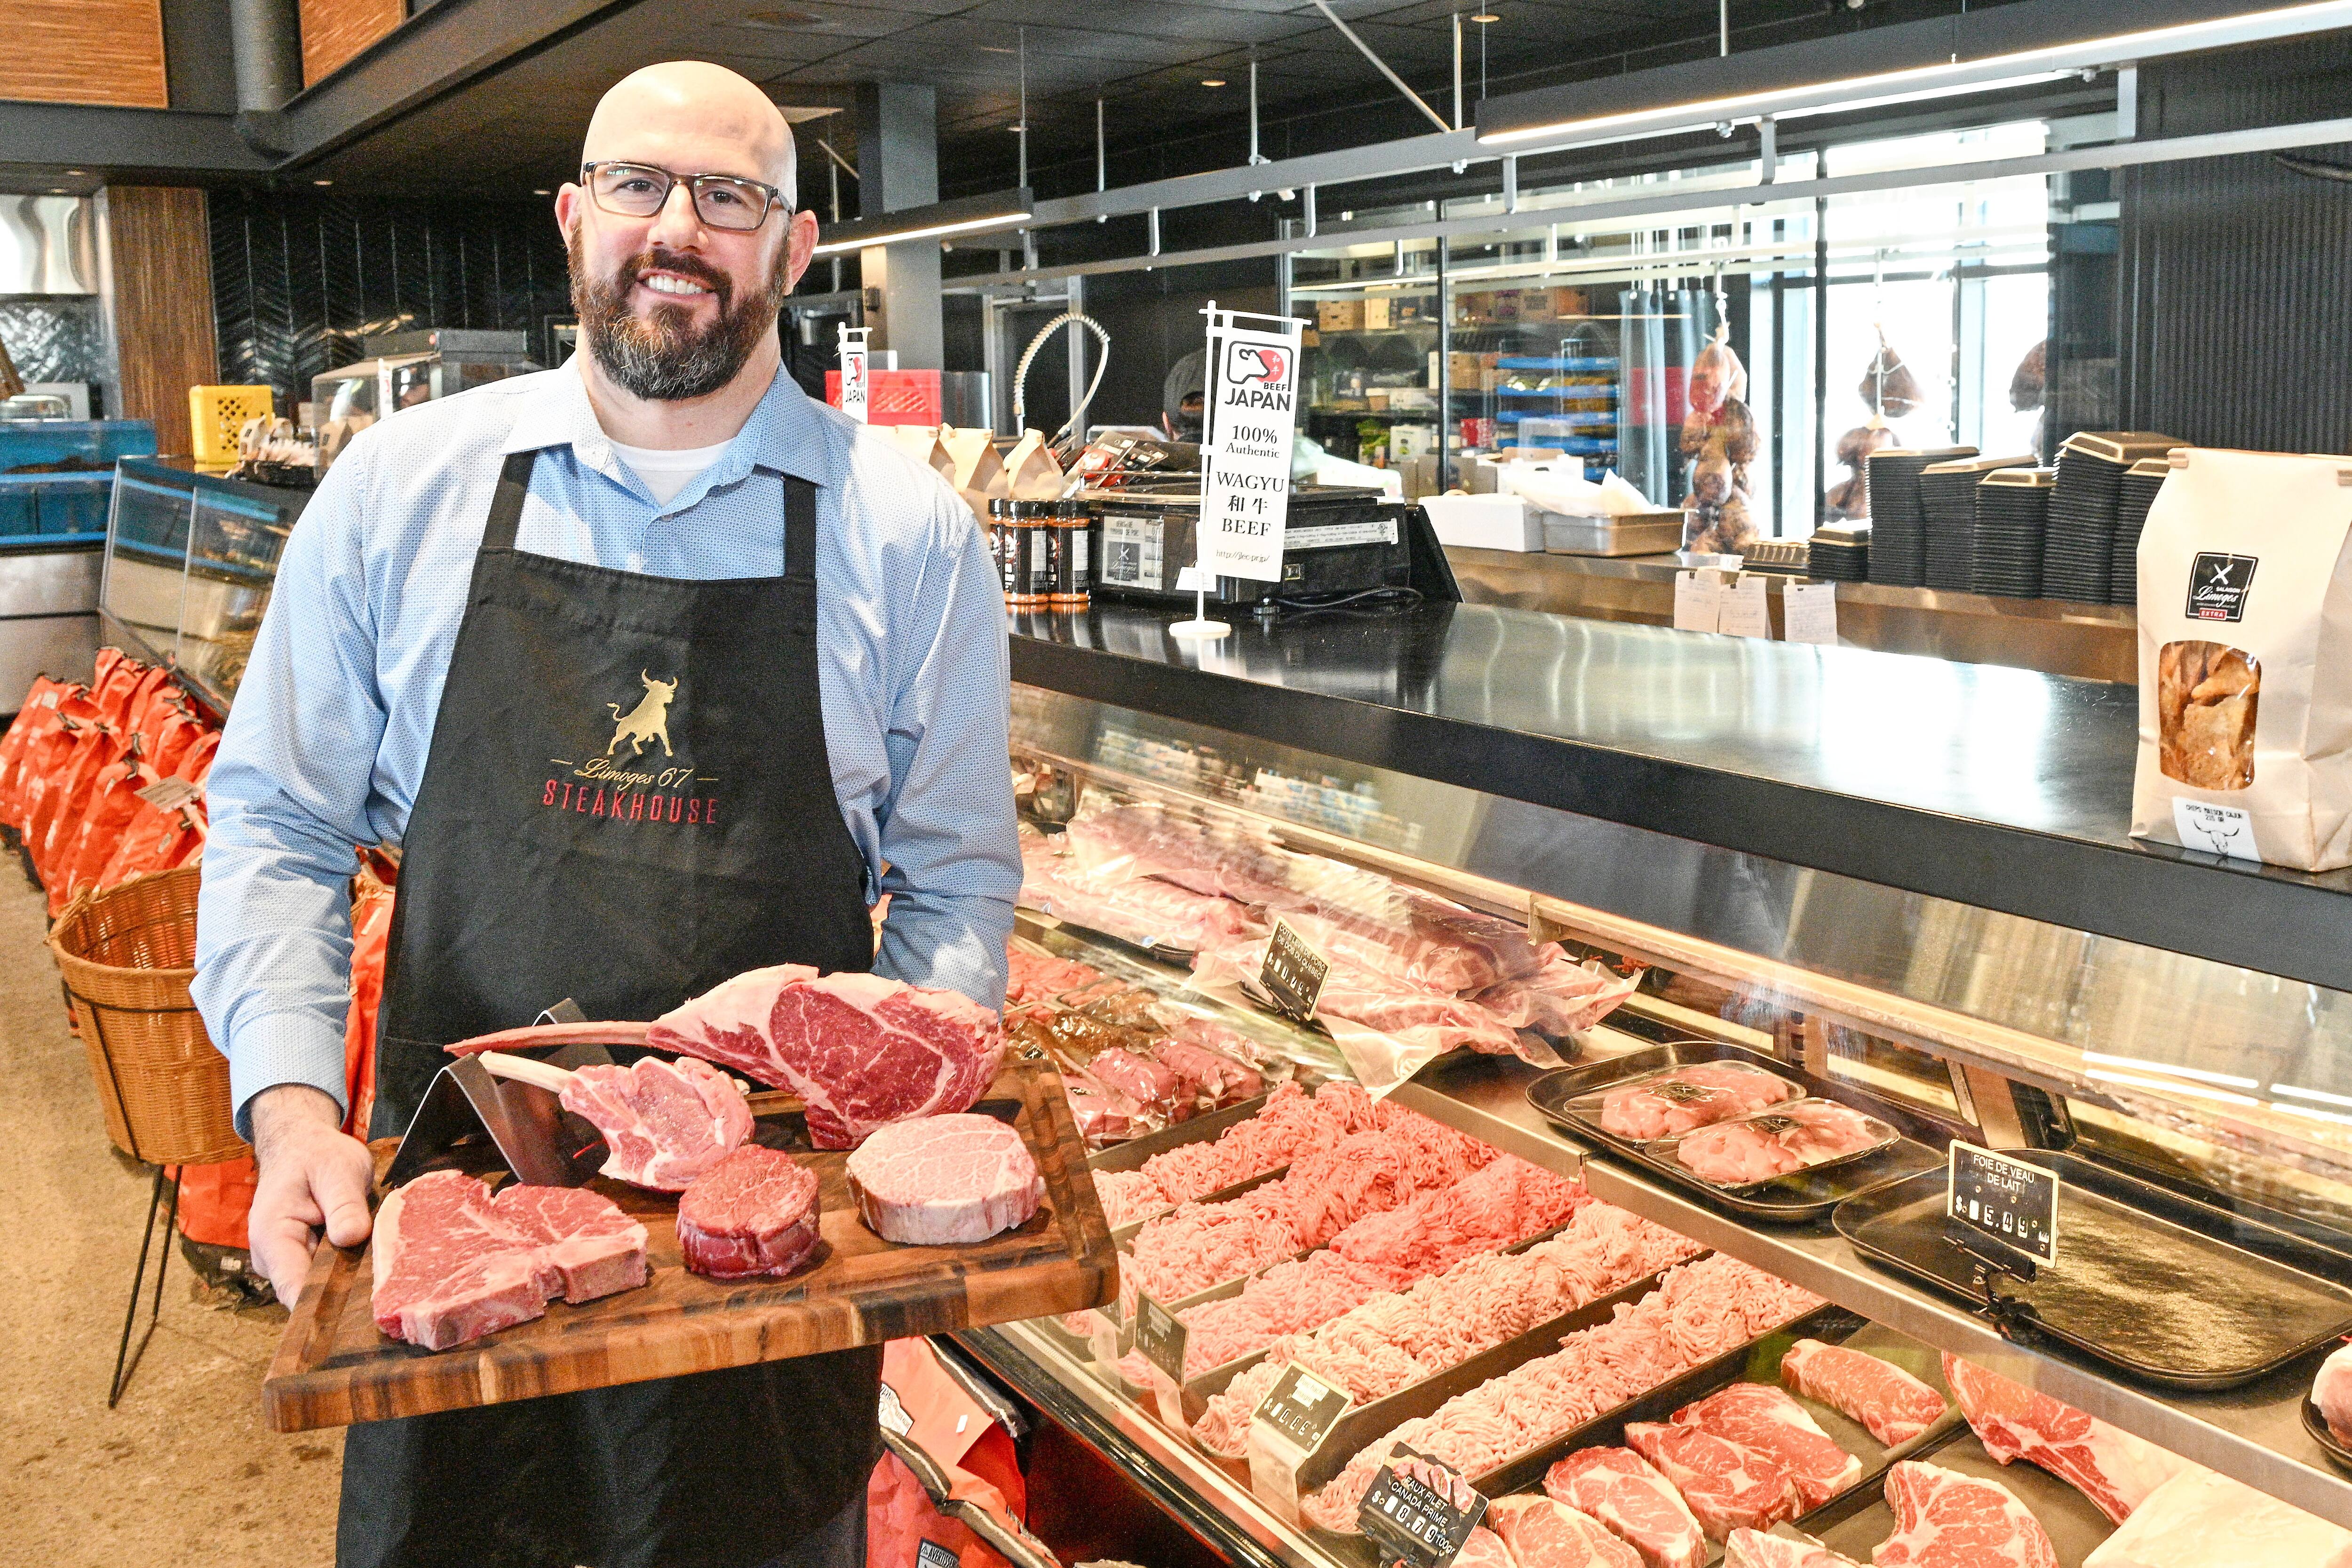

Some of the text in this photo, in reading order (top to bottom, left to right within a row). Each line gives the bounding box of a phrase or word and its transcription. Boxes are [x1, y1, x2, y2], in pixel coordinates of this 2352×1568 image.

[846, 390, 865, 403] JAPAN
[1263, 382, 1287, 391] BEEF
[1224, 388, 1290, 411] JAPAN
[1232, 425, 1277, 444] 100%
[1225, 442, 1280, 458] Authentic
[1216, 471, 1285, 492] WAGYU
[1221, 518, 1271, 536] BEEF
[2193, 585, 2239, 608] Limoges
[573, 758, 694, 791] Limoges 67
[542, 779, 718, 824] STEAKHOUSE
[1277, 934, 1285, 946] DE
[1295, 950, 1302, 962] DU
[1311, 955, 1326, 972] PORC
[1973, 1154, 2035, 1184] FOIE DE VEAU
[1987, 1172, 2021, 1192] DE LAIT
[1404, 1474, 1449, 1511] FAUX FILET
[1391, 1482, 1448, 1528] CANADA PRIME
